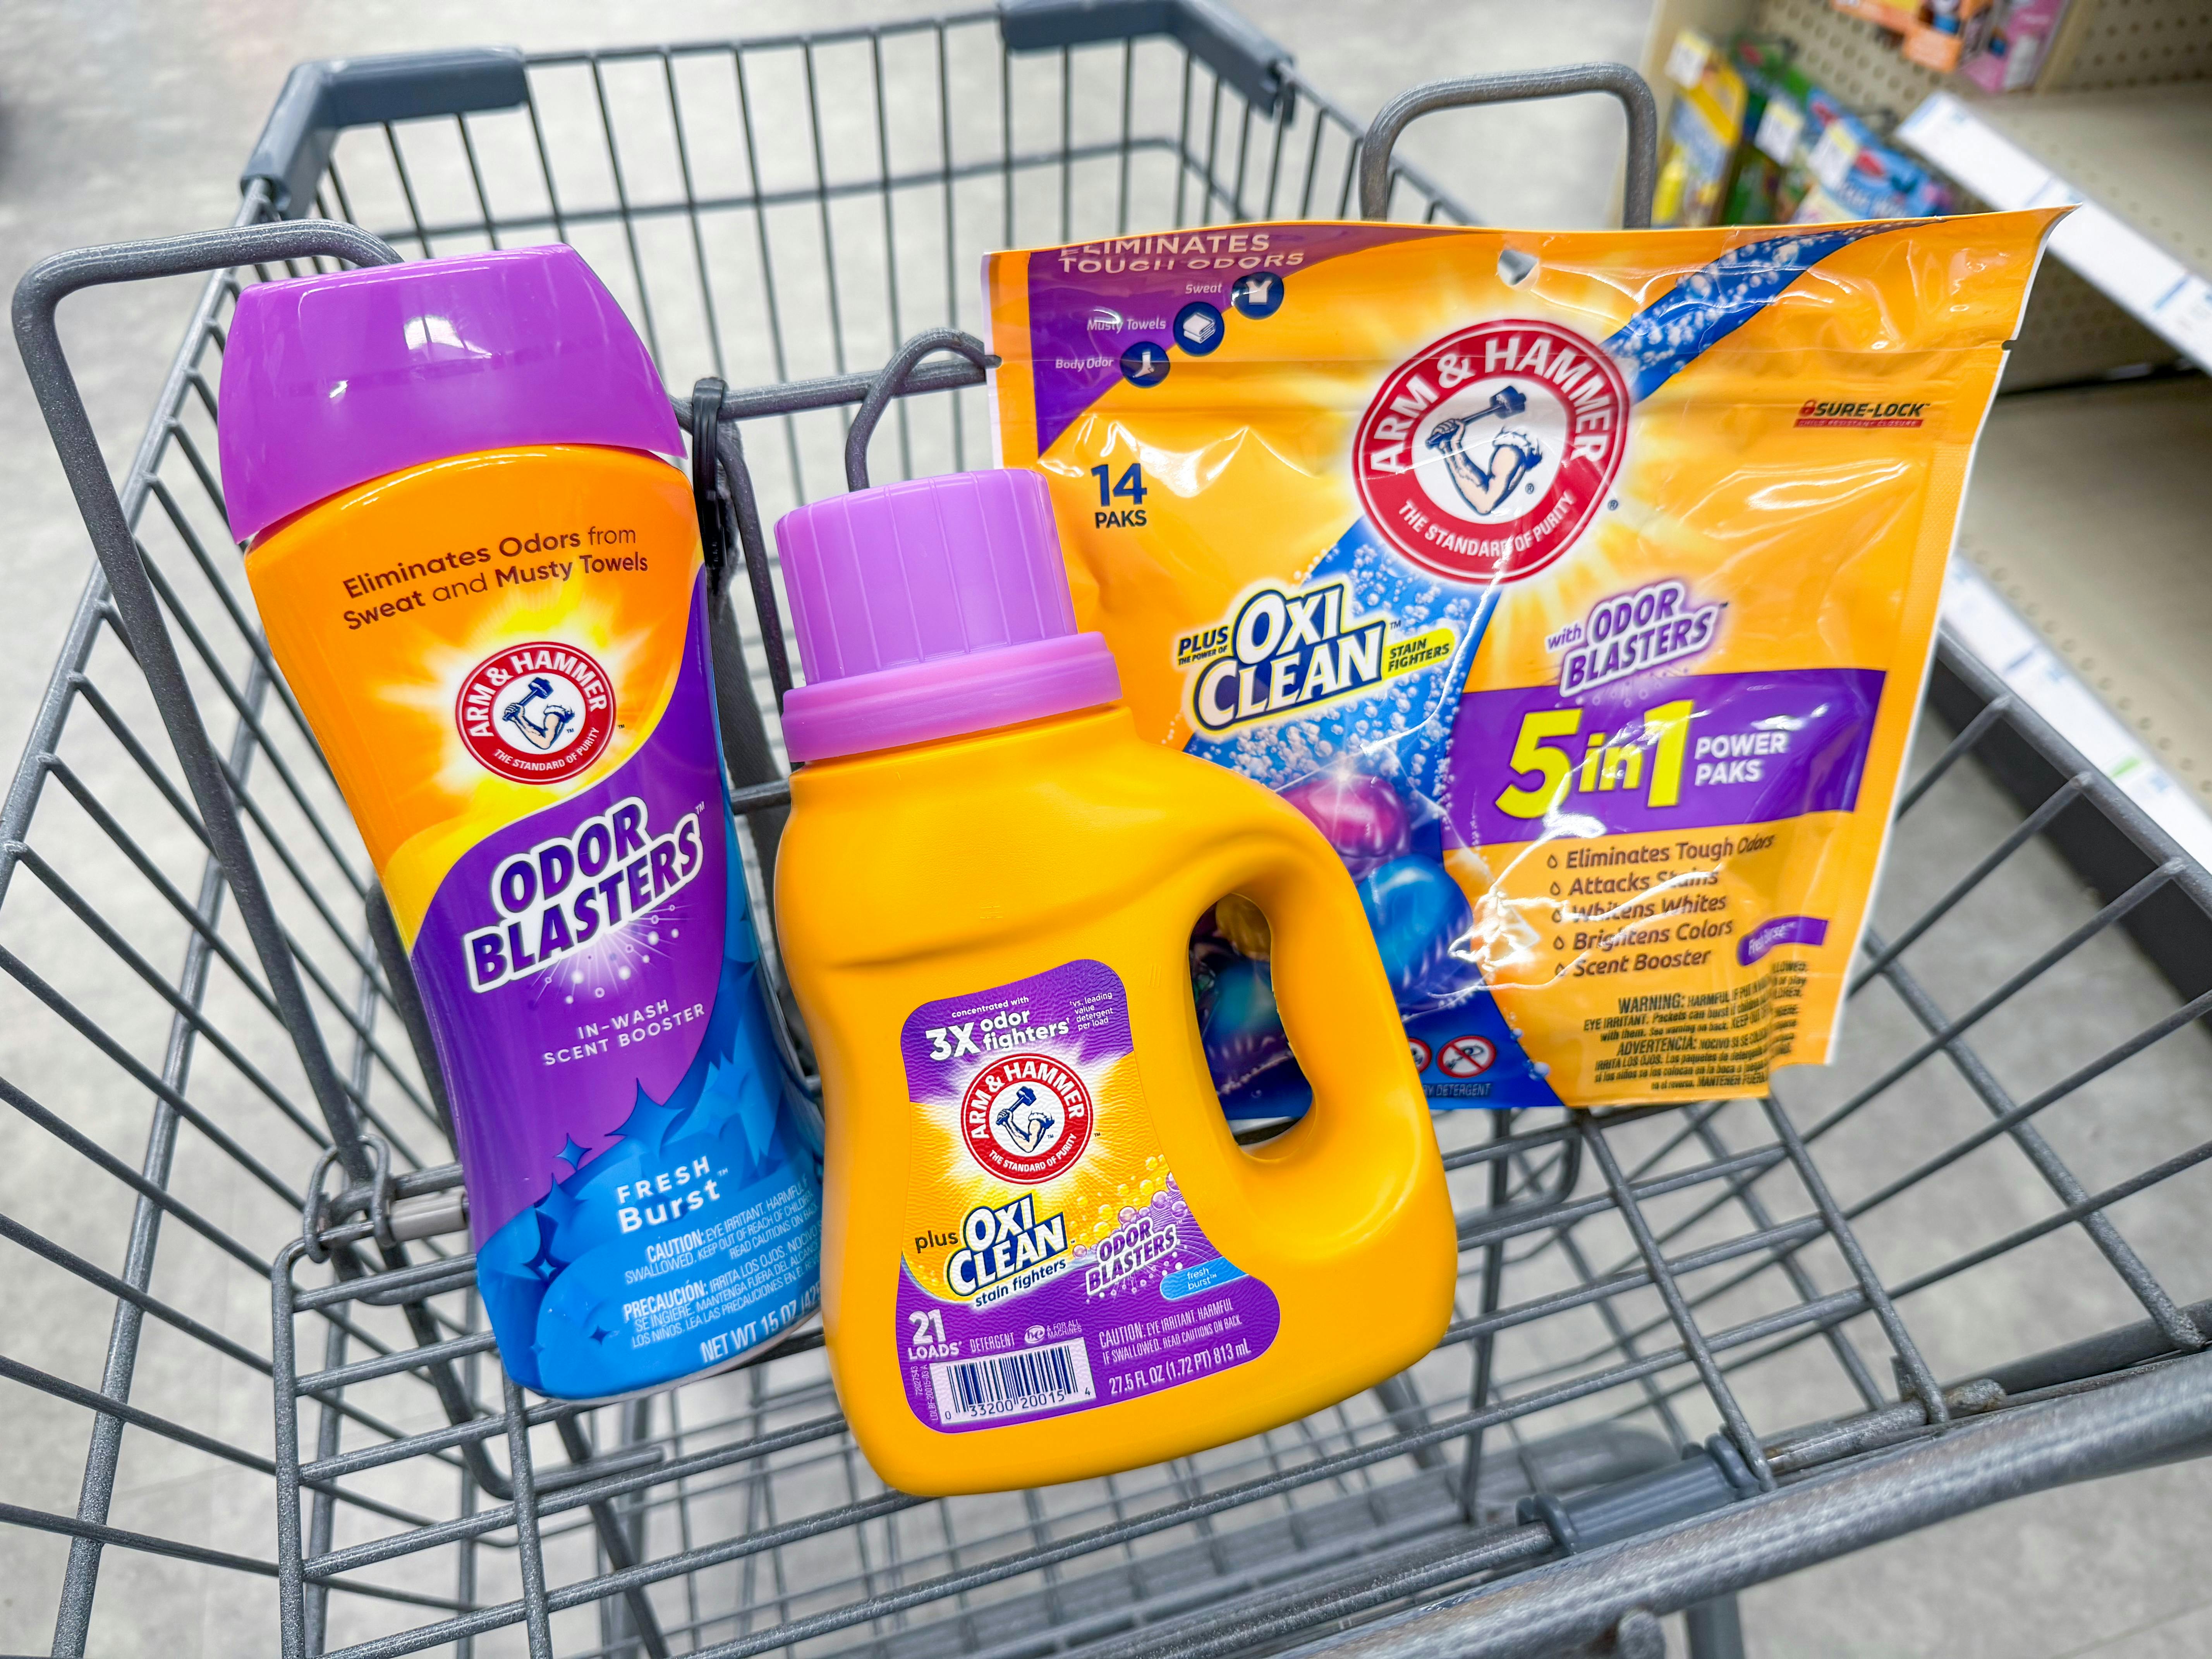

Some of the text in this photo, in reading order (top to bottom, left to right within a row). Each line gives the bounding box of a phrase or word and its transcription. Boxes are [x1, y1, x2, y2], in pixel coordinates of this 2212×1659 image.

[1058, 253, 1304, 274] TOUGH ODORS
[1185, 283, 1222, 294] Sweat
[1087, 318, 1166, 333] Musty Towels
[1055, 357, 1114, 370] Body Odor
[1370, 336, 1611, 473] ARM & HAMMER
[1814, 402, 1925, 417] SURE-LOCK
[1091, 463, 1147, 507] 14
[1095, 510, 1147, 529] PAKS
[1398, 500, 1426, 532] THE
[1515, 532, 1534, 552] OF
[1534, 491, 1575, 544] PURITY
[343, 526, 636, 599] Eliminates Odors from
[343, 552, 648, 630] Sweat and Musty Towels
[1236, 586, 1342, 665] OXI
[1548, 584, 1682, 649] with ODOR
[1178, 626, 1228, 656] PLUS
[1178, 645, 1227, 665] THE POWER OF
[1388, 644, 1449, 672] FIGHTERS
[1389, 638, 1427, 659] STAIN
[1563, 608, 1714, 694] BLASTERS
[468, 651, 607, 738] ARM & HAMMER
[1196, 622, 1384, 728] CLEAN
[494, 727, 599, 771] THE STANDARD OF PURITY
[1695, 732, 1787, 760] POWER
[1695, 761, 1761, 787] PAKS
[497, 801, 647, 916] ODOR
[1566, 833, 1775, 869] Eliminates Tough Odors
[469, 817, 701, 989] BLASTERS
[1568, 871, 1649, 896] Attacks
[1662, 894, 1726, 917] Whites
[1676, 919, 1733, 941] Colors
[1573, 949, 1712, 977] Scent Booster
[951, 996, 1029, 1018] concentrated with
[1075, 1005, 1095, 1014] value
[1077, 1007, 1113, 1022] detergent
[1084, 993, 1112, 1004] leading
[1618, 992, 1685, 1014] WARNING:
[544, 1003, 705, 1065] SCENT BOOSTER
[578, 1000, 668, 1039] IN-WASH
[980, 1010, 1030, 1032] odor
[1078, 1016, 1109, 1032] per load
[1584, 1018, 1601, 1031] EYE
[925, 1022, 979, 1061] 3X
[970, 1061, 1085, 1140] ARM & HAMMER
[1436, 1083, 1491, 1096] DETERGENT
[989, 1132, 1077, 1173] THE STANDARD OF PURITY
[617, 1156, 710, 1204] FRESH
[618, 1178, 720, 1234] Burst
[647, 1181, 804, 1263] CAUTION: EYE IRRITANT. HARMFUL
[964, 1195, 1034, 1251] OXI
[625, 1209, 783, 1285] SWALLOWED. KEEP OUT OF REACH OF
[729, 1240, 752, 1259] READ
[752, 1220, 791, 1248] CAUTIONS
[791, 1215, 804, 1228] ON
[915, 1231, 958, 1254] plus
[947, 1212, 1068, 1296] CLEAN
[1099, 1218, 1153, 1262] ODOR
[623, 1279, 708, 1324] PRECAUCIÓN:
[709, 1269, 740, 1293] IRRITA
[740, 1259, 759, 1278] LOS
[760, 1245, 788, 1267] OJOS.
[787, 1224, 818, 1253] NOCIVO
[1087, 1224, 1176, 1295] BLASTERS
[1187, 1267, 1209, 1280] fresh
[635, 1317, 650, 1333] SE
[651, 1302, 695, 1328] INGIERE.
[697, 1281, 748, 1312] MANTENGA
[747, 1268, 775, 1288] FUERA
[774, 1260, 790, 1275] DEL
[791, 1240, 818, 1267] ALCANC
[975, 1258, 1066, 1308] stain fighters
[632, 1332, 651, 1348] LOS
[686, 1315, 703, 1331] LEA
[703, 1307, 721, 1323] LAS
[721, 1277, 784, 1316] PRECAUCIONES
[784, 1271, 797, 1285] EN
[908, 1309, 946, 1345] 21
[1053, 1322, 1066, 1330] FOR
[1099, 1298, 1233, 1348] CAUTION: EYE IRRITANT. HARMFUL
[701, 1310, 779, 1364] NET WT 15
[970, 1332, 1015, 1354] DETERGENT
[1048, 1325, 1082, 1338] MACHINES
[1103, 1314, 1242, 1365] IF SWALLOWED. READ CAUTIONS ON BACK.
[910, 1366, 923, 1396] 72027543
[1108, 1338, 1252, 1395] 27.5 FL OZ (1.72 PT) 813 mL
[945, 1387, 1091, 1419] 0 33200 20015 4
